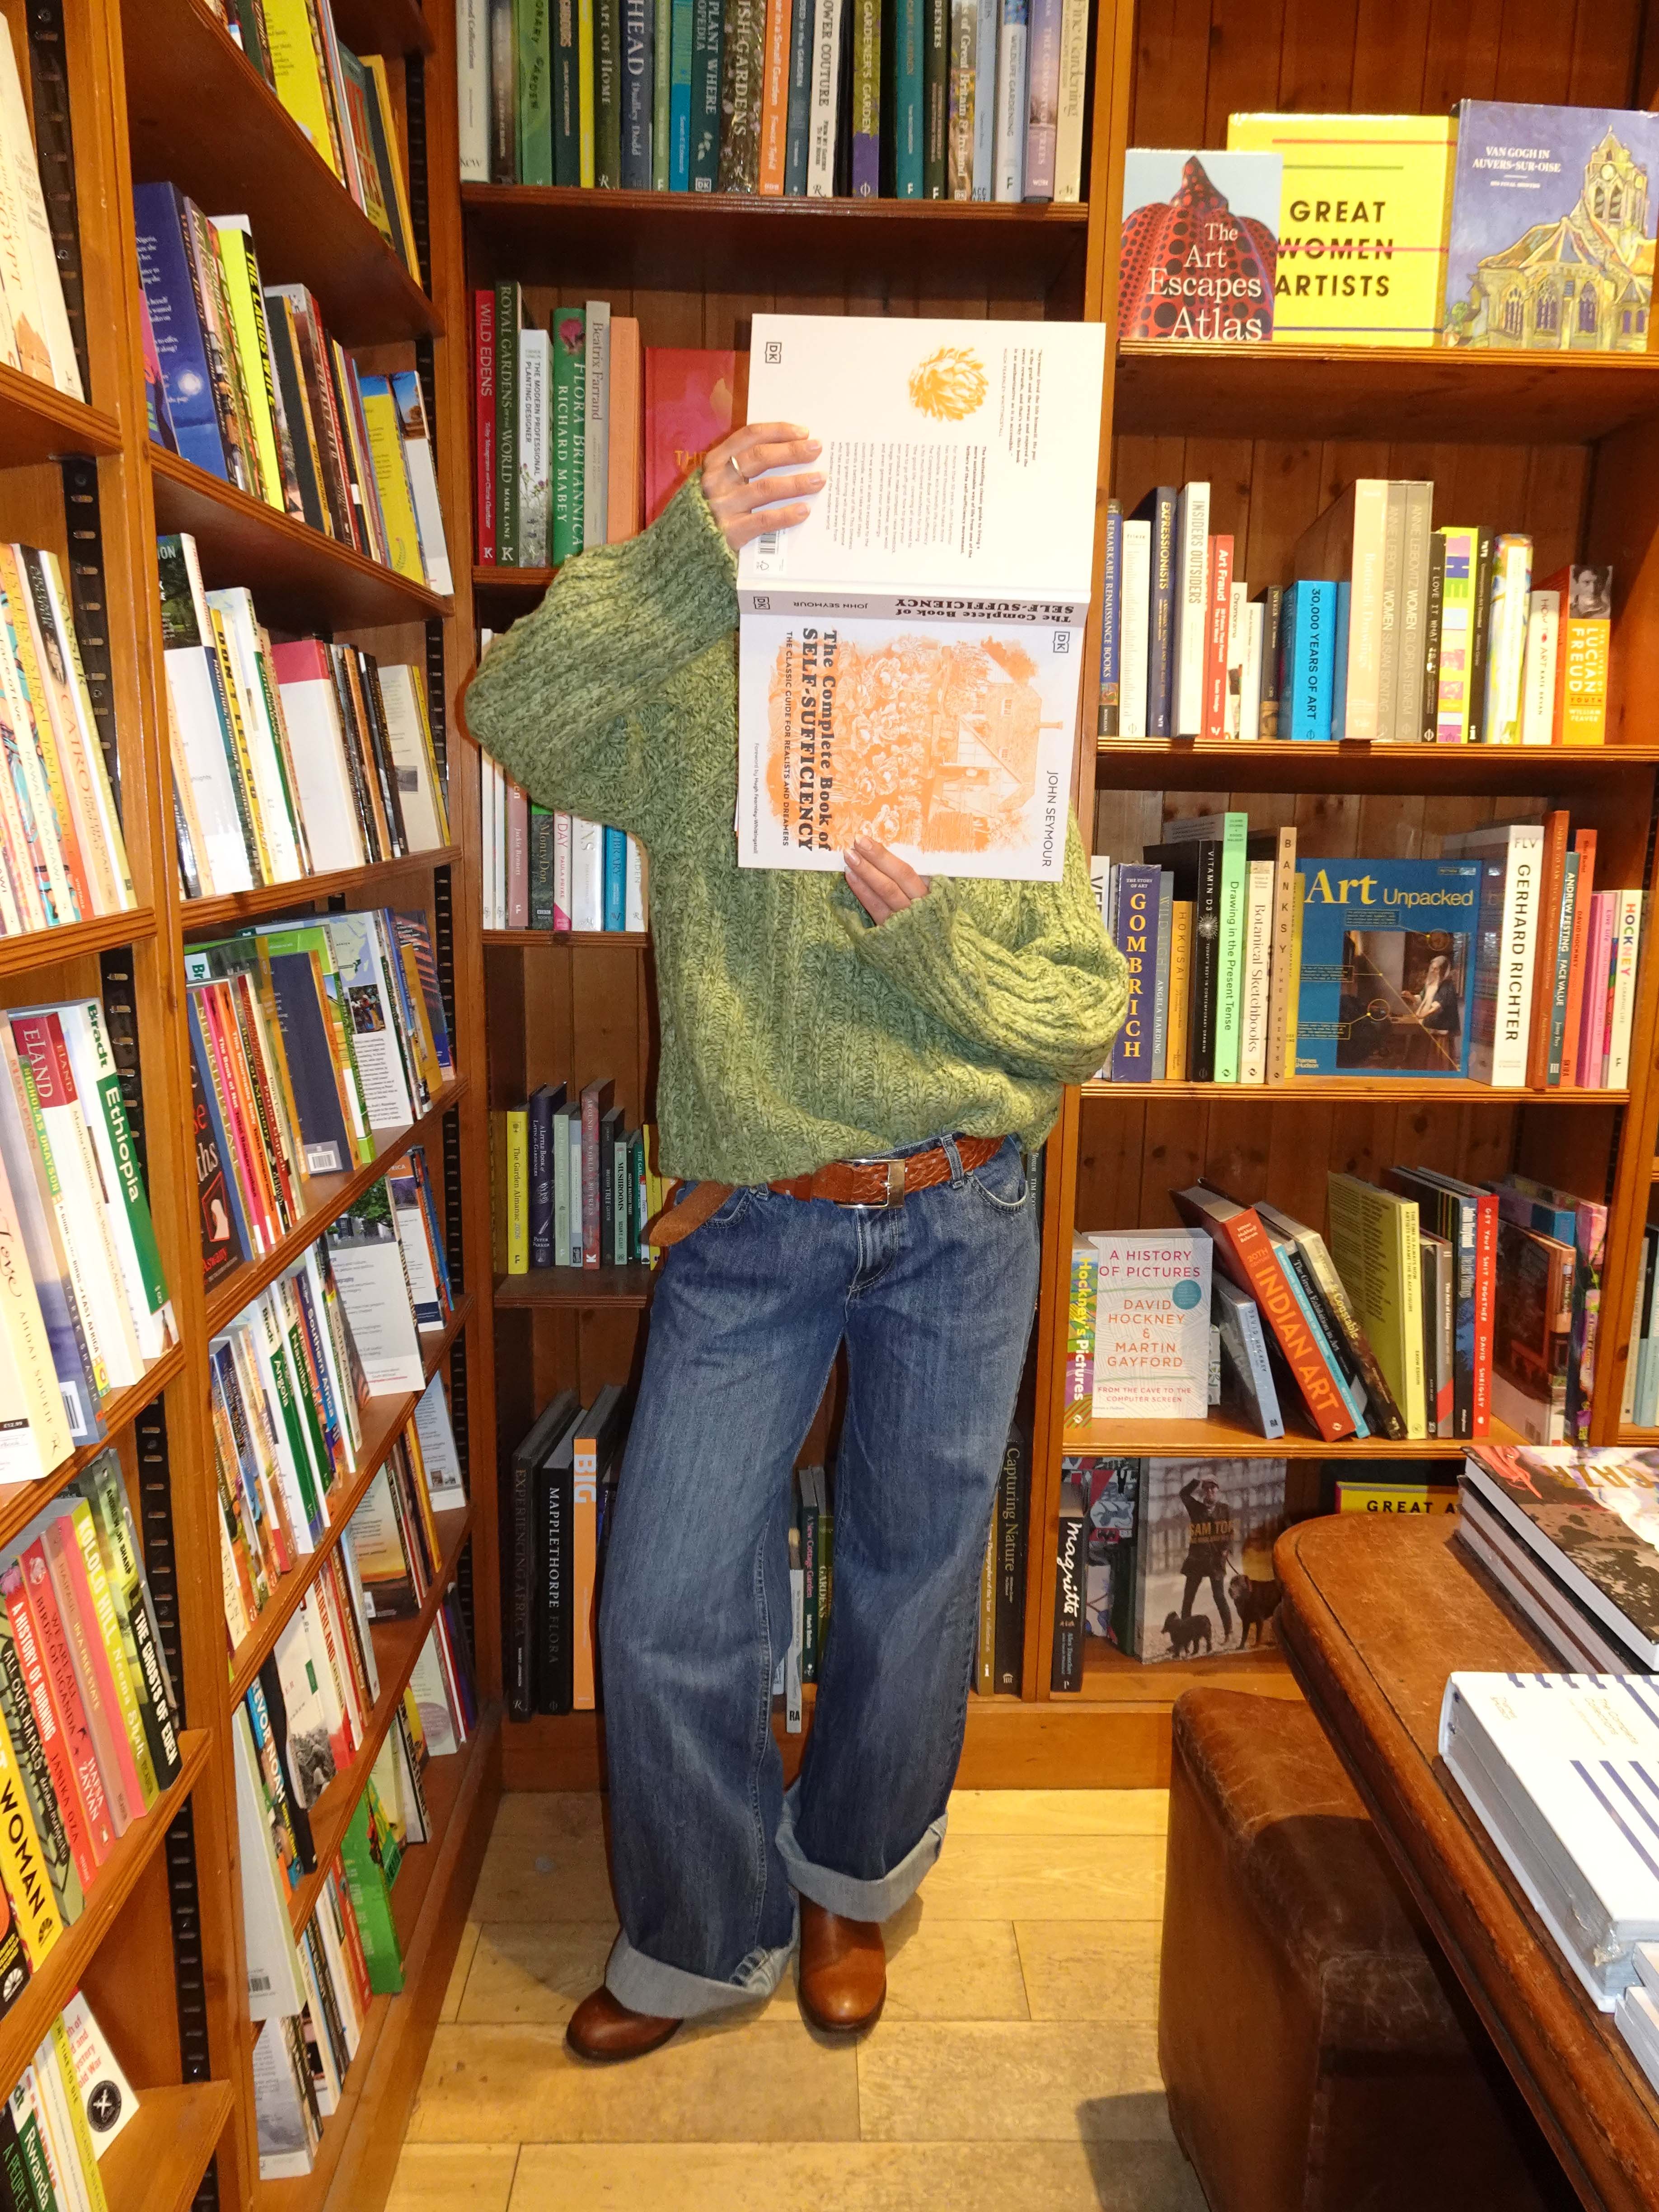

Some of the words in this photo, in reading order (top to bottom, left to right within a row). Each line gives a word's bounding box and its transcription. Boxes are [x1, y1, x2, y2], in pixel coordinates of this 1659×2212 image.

[733, 40, 749, 135] GARDENS
[819, 45, 832, 107] COUTURE
[1472, 159, 1561, 173] AUVERS-SUR-OISE
[1486, 146, 1506, 158] VAN
[1508, 148, 1537, 158] GOGH
[1539, 150, 1550, 159] IN
[1204, 223, 1238, 240] The
[1290, 201, 1386, 222] GREAT
[1184, 245, 1228, 268] Art
[1278, 238, 1394, 260] WOMEN
[1147, 267, 1261, 303] Escapes
[1275, 275, 1390, 296] ARTISTS
[246, 252, 258, 286] THE
[252, 291, 268, 353] LAGOS
[262, 363, 275, 406] WIFE
[479, 303, 492, 342] WILD
[500, 286, 512, 335] ROYAL
[1168, 307, 1262, 341] Atlas
[592, 322, 604, 368] Beatrix
[479, 347, 492, 397] EDENS
[500, 339, 512, 408] GARDENS
[574, 363, 586, 422] FLORA
[592, 370, 604, 420] Farrand
[558, 385, 568, 461] RICHARD
[501, 427, 512, 483] WORLD
[557, 469, 567, 523] MABEY
[573, 434, 585, 546] BRITANNICA
[1106, 520, 1115, 581] REMARKABLE
[1218, 550, 1228, 567] Art
[895, 598, 1074, 614] SELF-SUFFICIENCY
[1216, 569, 1227, 602] Fraud
[917, 610, 956, 618] Book
[965, 612, 1036, 622] Complete
[1104, 582, 1114, 647] RENAISSANCE
[1310, 589, 1321, 629] 30,000
[1405, 590, 1418, 631] WOMEN
[823, 630, 837, 668] The
[1103, 647, 1113, 678] BOOKS
[1309, 634, 1320, 672] YEARS
[1569, 628, 1585, 691] FREUD
[1584, 628, 1598, 692] LUCIAN
[1308, 676, 1317, 693] OF
[819, 675, 836, 769] Complete
[1308, 696, 1317, 720] ART
[798, 628, 818, 851] SELF-SUFFICIENCY
[820, 773, 834, 825] Book
[1046, 770, 1059, 804] JOHN
[782, 801, 791, 846] DREAMERS
[819, 829, 832, 851] of
[1041, 808, 1057, 867] SEYMOUR
[1206, 851, 1214, 894] VITAMIN
[1304, 869, 1378, 904] Art
[1383, 889, 1473, 907] Unpacked
[1564, 872, 1575, 911] ANDREW
[1206, 899, 1213, 911] D3
[1228, 881, 1239, 925] Drawing
[1279, 839, 1291, 953] BANKSY
[1512, 864, 1531, 957] GERHARD
[1175, 912, 1186, 980] HOKUSAI
[1228, 928, 1237, 937] in
[1228, 940, 1236, 957] the
[1251, 904, 1265, 965] Botanical
[1560, 913, 1572, 952] FESTING
[1621, 903, 1636, 977] HOCKNEY
[1123, 894, 1147, 1058] GOMBRICH
[1226, 960, 1237, 999] Present
[1559, 959, 1567, 979] FACE
[1247, 970, 1263, 1052] Sketchbooks
[1504, 964, 1523, 1042] RICHTER
[1555, 979, 1565, 1007] VALUE
[1225, 1000, 1234, 1031] Tense
[23, 1029, 54, 1098] ELAND
[87, 1005, 109, 1068] Bradt
[105, 1087, 139, 1203] Ethiopia
[1099, 1267, 1120, 1276] OF
[1127, 1267, 1201, 1277] PICTURES
[1110, 1251, 1119, 1260] A
[1126, 1251, 1192, 1261] HISTORY
[1076, 1257, 1092, 1339] Hockney's
[1109, 1314, 1185, 1324] HOCKNEY
[1124, 1300, 1171, 1309] DAVID
[1115, 1343, 1176, 1352] MARTIN
[1255, 1265, 1312, 1359] INDIAN
[1298, 1367, 1340, 1411] ART
[274, 1361, 288, 1407] Angola
[292, 1333, 308, 1397] Namibia
[308, 1308, 324, 1373] Southern
[321, 1378, 333, 1417] Africa
[1074, 1340, 1090, 1401] Pictures
[1107, 1357, 1183, 1367] GAYFORD
[1477, 1368, 1485, 1407] SHRIGLEY
[574, 1454, 596, 1503] BIG
[1002, 1448, 1021, 1519] Capturing
[1367, 1500, 1432, 1513] GREAT
[548, 1487, 560, 1608] MAPPLETHORPE
[1004, 1522, 1019, 1572] Nature
[77, 1516, 107, 1595] KOLOLO
[96, 1594, 118, 1645] HILL
[11, 1601, 24, 1614] A
[135, 1609, 151, 1646] THE
[15, 1611, 38, 1668] HISTORY
[29, 1666, 42, 1683] OF
[141, 1641, 162, 1700] GHOSTS
[35, 1683, 57, 1741] BURNING
[156, 1700, 169, 1722] OF
[161, 1722, 178, 1766] EDEN
[1, 1779, 45, 1919] WOMAN
[24, 2125, 49, 2210] Rwanda
